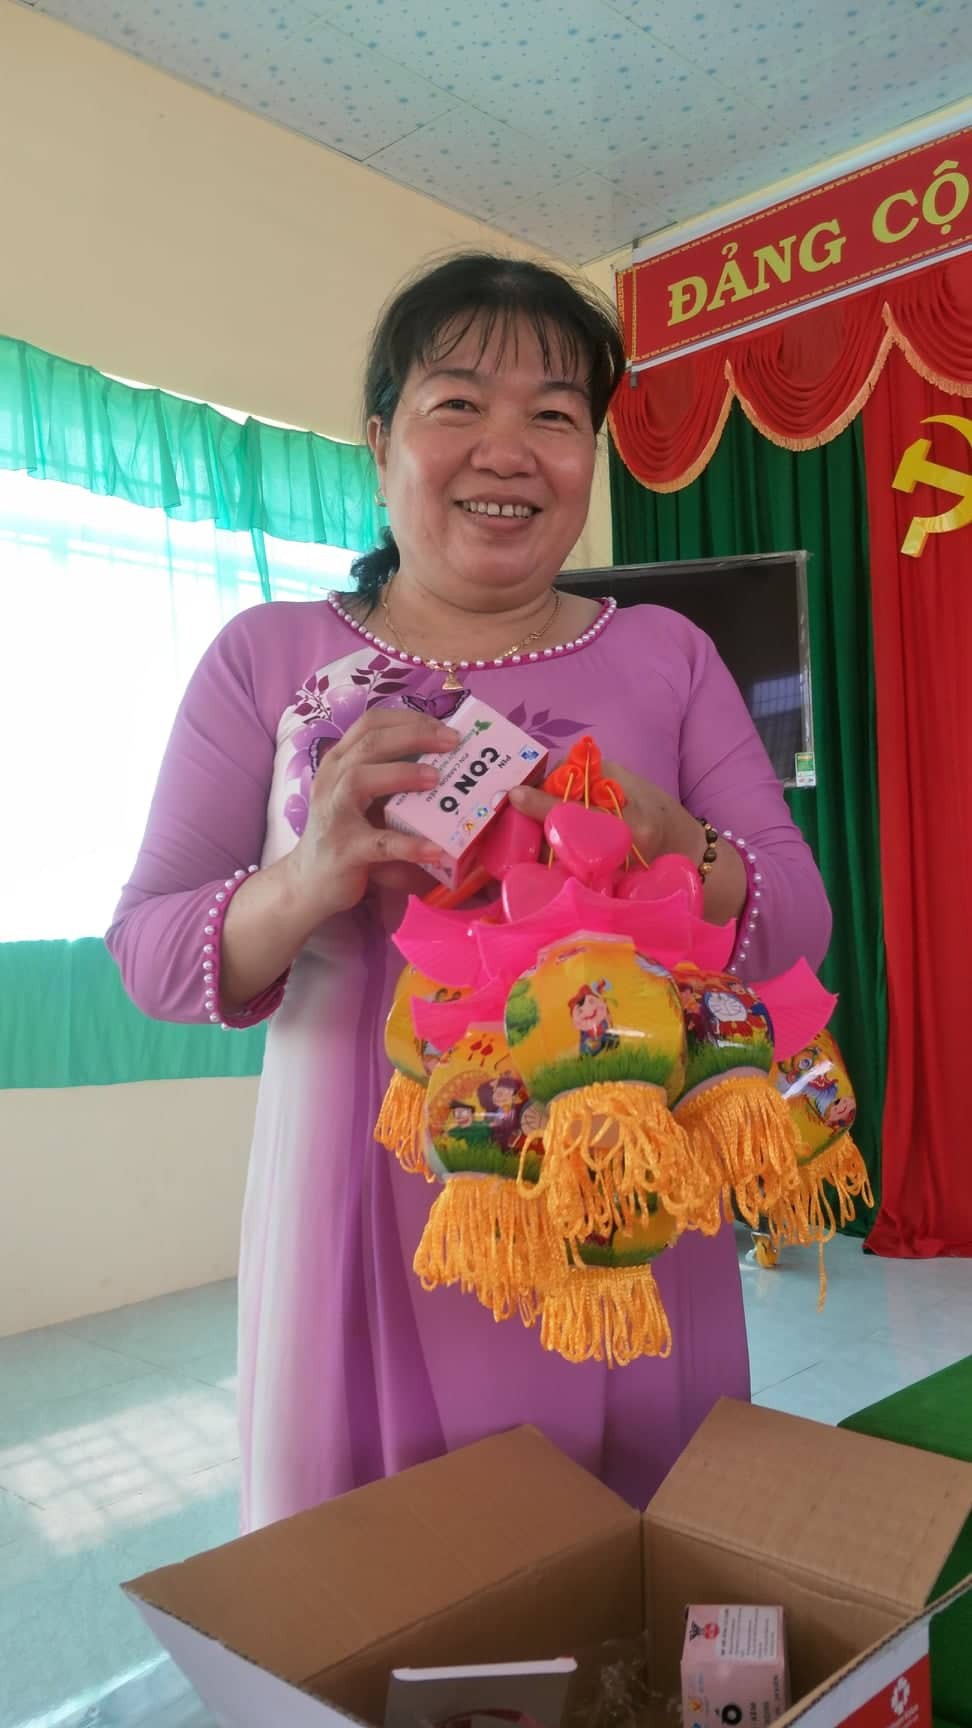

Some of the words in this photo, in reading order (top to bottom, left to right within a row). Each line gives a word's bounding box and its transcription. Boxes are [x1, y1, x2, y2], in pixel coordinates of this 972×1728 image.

[667, 219, 847, 327] ĐẢNG
[871, 159, 970, 244] CỘ
[454, 747, 500, 795] CON
[498, 754, 512, 769] PIN
[439, 796, 461, 816] Ó
